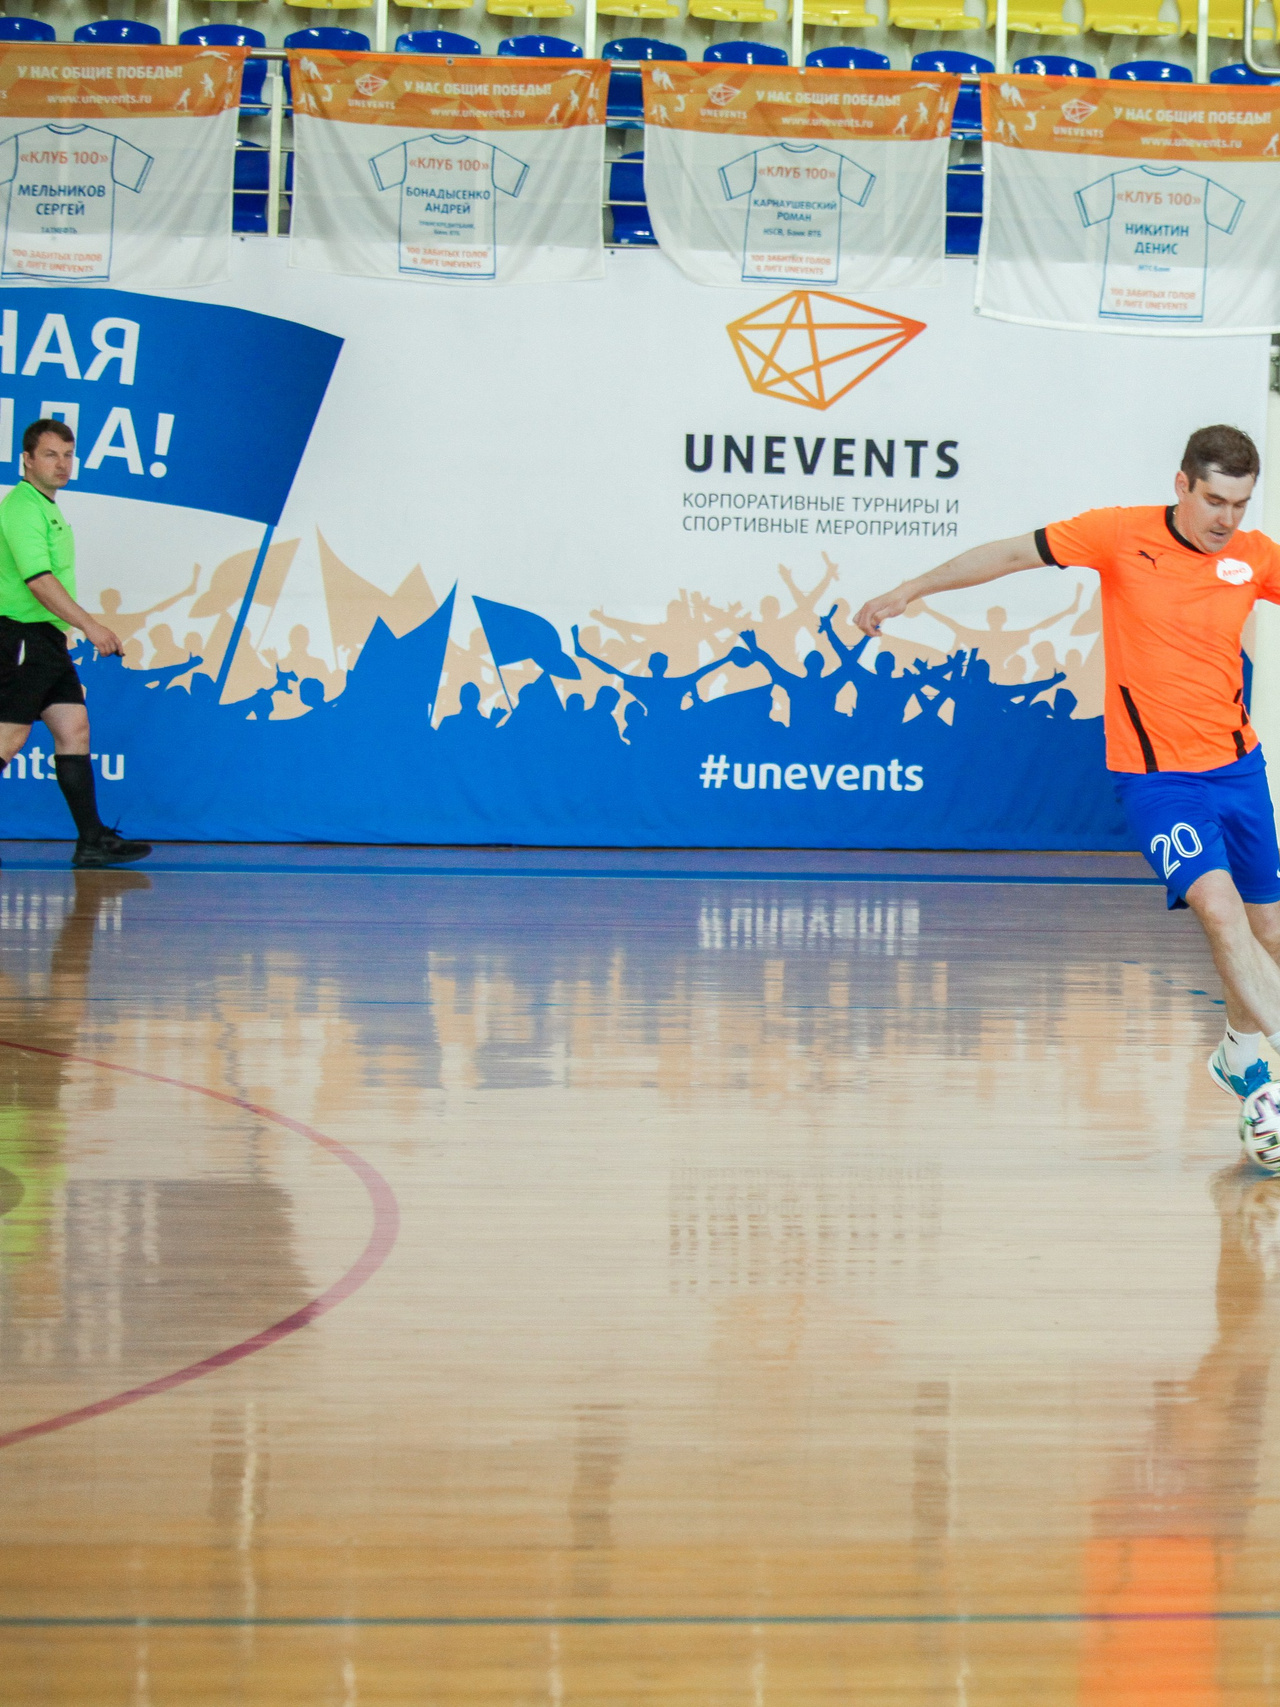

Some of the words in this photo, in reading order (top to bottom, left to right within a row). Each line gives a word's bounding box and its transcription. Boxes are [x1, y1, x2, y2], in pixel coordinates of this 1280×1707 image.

[17, 66, 27, 79] У
[30, 66, 58, 79] НАС
[62, 66, 113, 80] ОБЩИЕ
[117, 66, 183, 80] ПОБЕДЫ!
[404, 81, 413, 92] У
[415, 81, 440, 94] НАС
[443, 82, 489, 96] ОБЩИЕ
[492, 84, 551, 96] ПОБЕДЫ!
[47, 94, 152, 104] www.unevents.ru
[348, 99, 395, 110] UNEVENTS
[756, 90, 765, 101] У
[767, 91, 791, 103] НАС
[795, 92, 839, 105] ОБЩИЕ
[842, 94, 900, 106] ПОБЕДЫ!
[430, 108, 525, 118] www.unevents.ru
[700, 108, 747, 119] UNEVENTS
[1114, 107, 1123, 119] У
[1125, 107, 1152, 121] НАС
[1155, 109, 1205, 124] ОБЩИЕ
[1208, 111, 1271, 125] ПОБЕДЫ!
[782, 117, 873, 128] www.unevents.ru
[1053, 126, 1104, 138] UNEVENTS
[1141, 137, 1242, 148] www.unevents.ru
[20, 151, 68, 165] «КЛУБ
[74, 151, 108, 165] 100»
[409, 158, 453, 171] «КЛУБ
[458, 160, 489, 172] 100»
[758, 166, 801, 179] «КЛУБ
[805, 167, 836, 180] 100»
[18, 184, 106, 198] МЕЛЬНИКОВ
[406, 186, 491, 201] БОНАДЫСЕНКО
[1116, 190, 1163, 205] «КЛУБ
[1168, 192, 1201, 206] 100»
[36, 200, 85, 216] СЕРГЕЙ
[425, 202, 470, 215] АНДРЕЙ
[753, 199, 837, 210] КАРНАУШЕВСКИЙ
[777, 211, 811, 221] РОМАН
[1125, 223, 1189, 238] НИКИТИН
[1134, 242, 1178, 256] ДЕНИС
[685, 434, 959, 479] UNEVENTS
[683, 493, 845, 512] КОРПОРАТИВНЫЕ
[854, 497, 939, 514] ТУРНИРЫ
[946, 500, 959, 514] И
[683, 516, 809, 534] СПОРТИВНЫЕ
[816, 519, 958, 537] МЕРОПРИЯТИЯ
[699, 754, 924, 791] #unevents
[1150, 822, 1203, 880] 20
